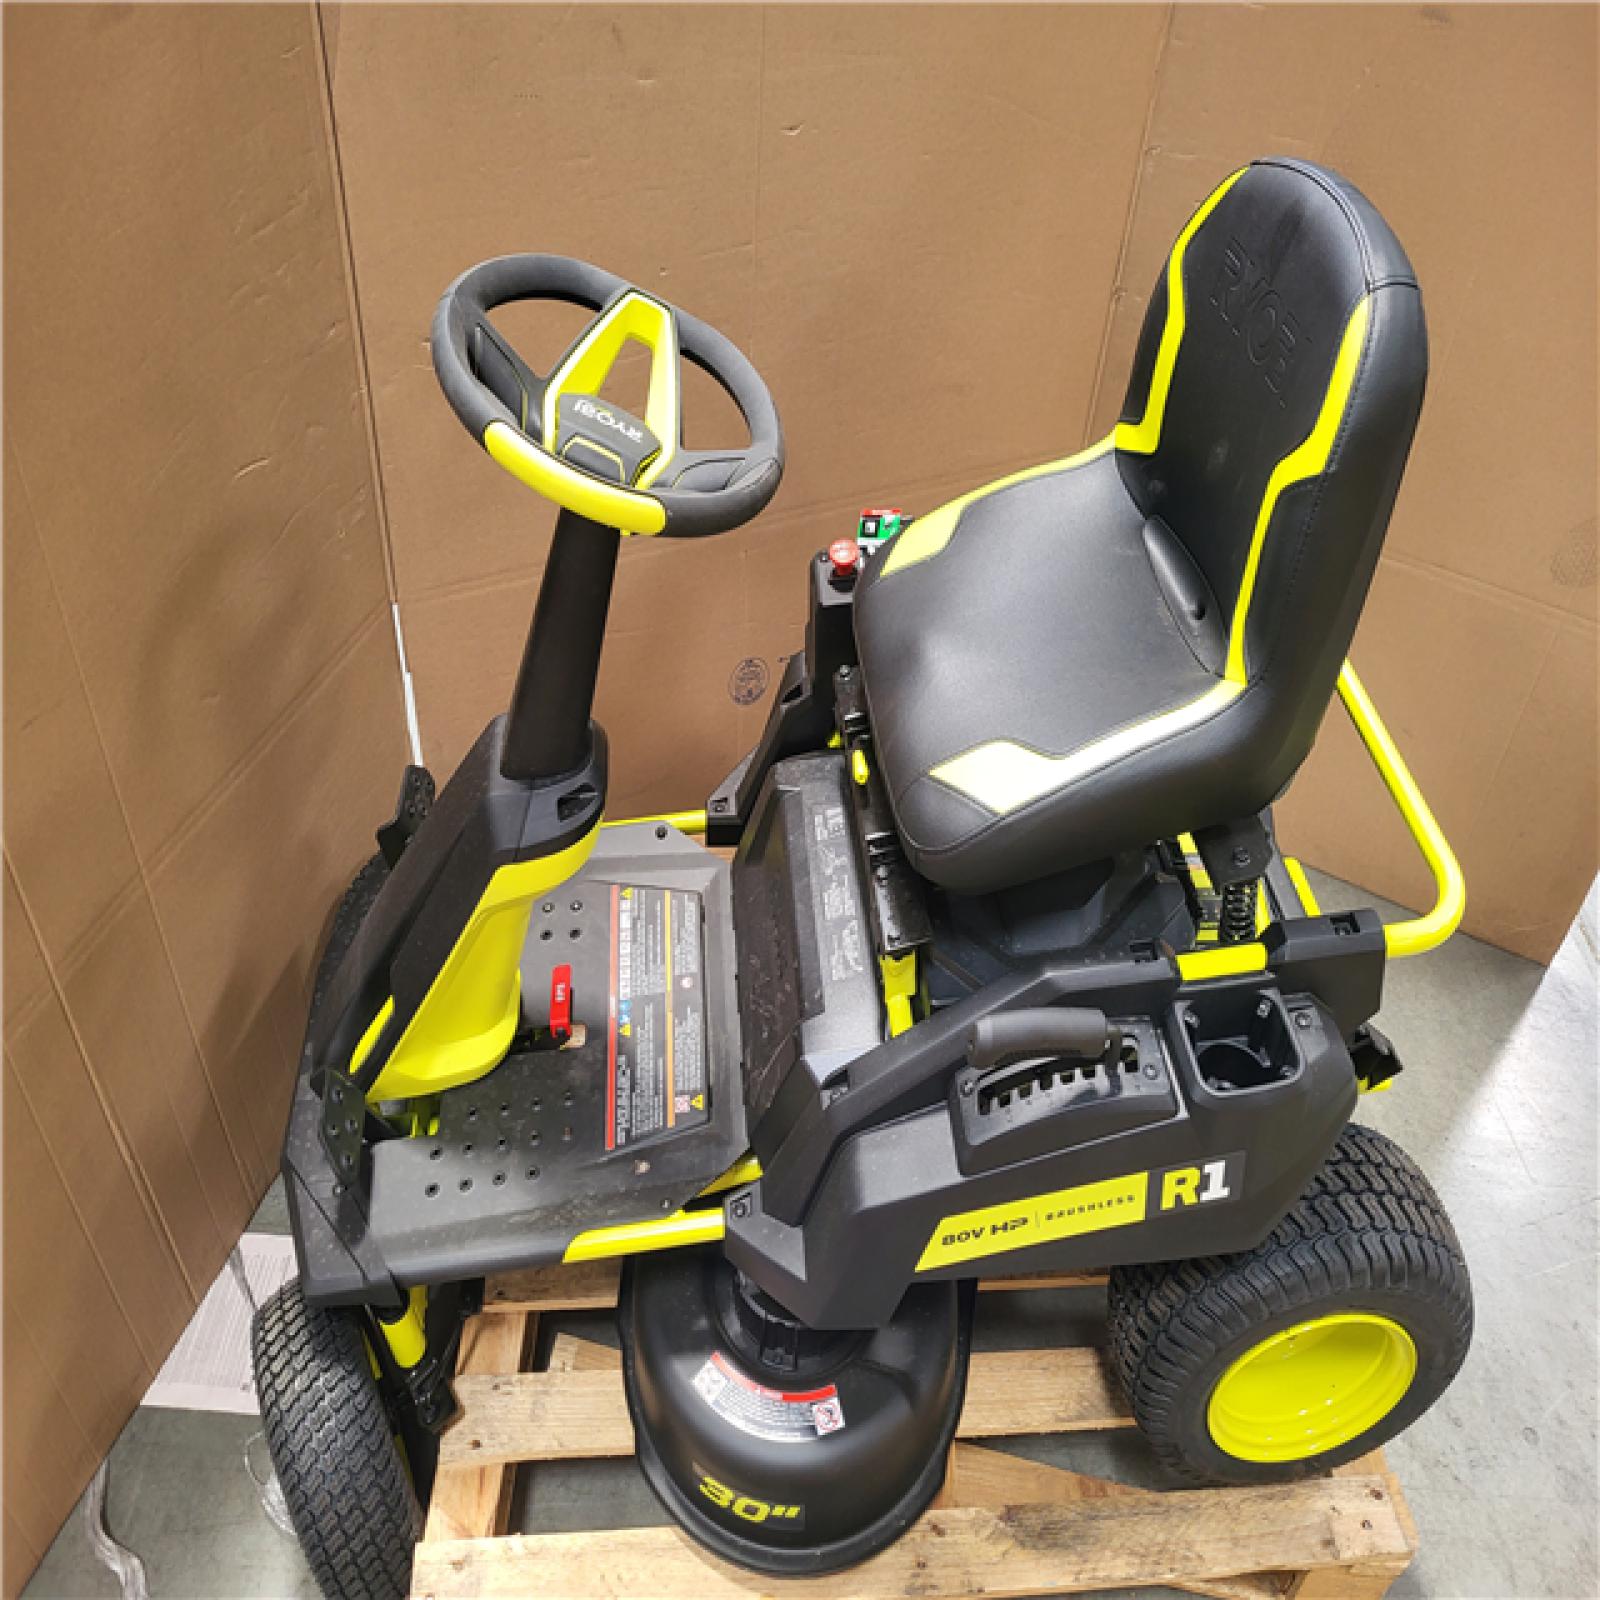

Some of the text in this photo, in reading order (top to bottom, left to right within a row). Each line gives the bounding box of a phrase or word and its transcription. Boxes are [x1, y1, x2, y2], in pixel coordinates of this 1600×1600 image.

[573, 399, 642, 442] RYOBI
[1160, 1160, 1231, 1210] R1
[942, 1194, 1135, 1246] 80V HP BRUSHLESS
[699, 1476, 801, 1522] 30"
